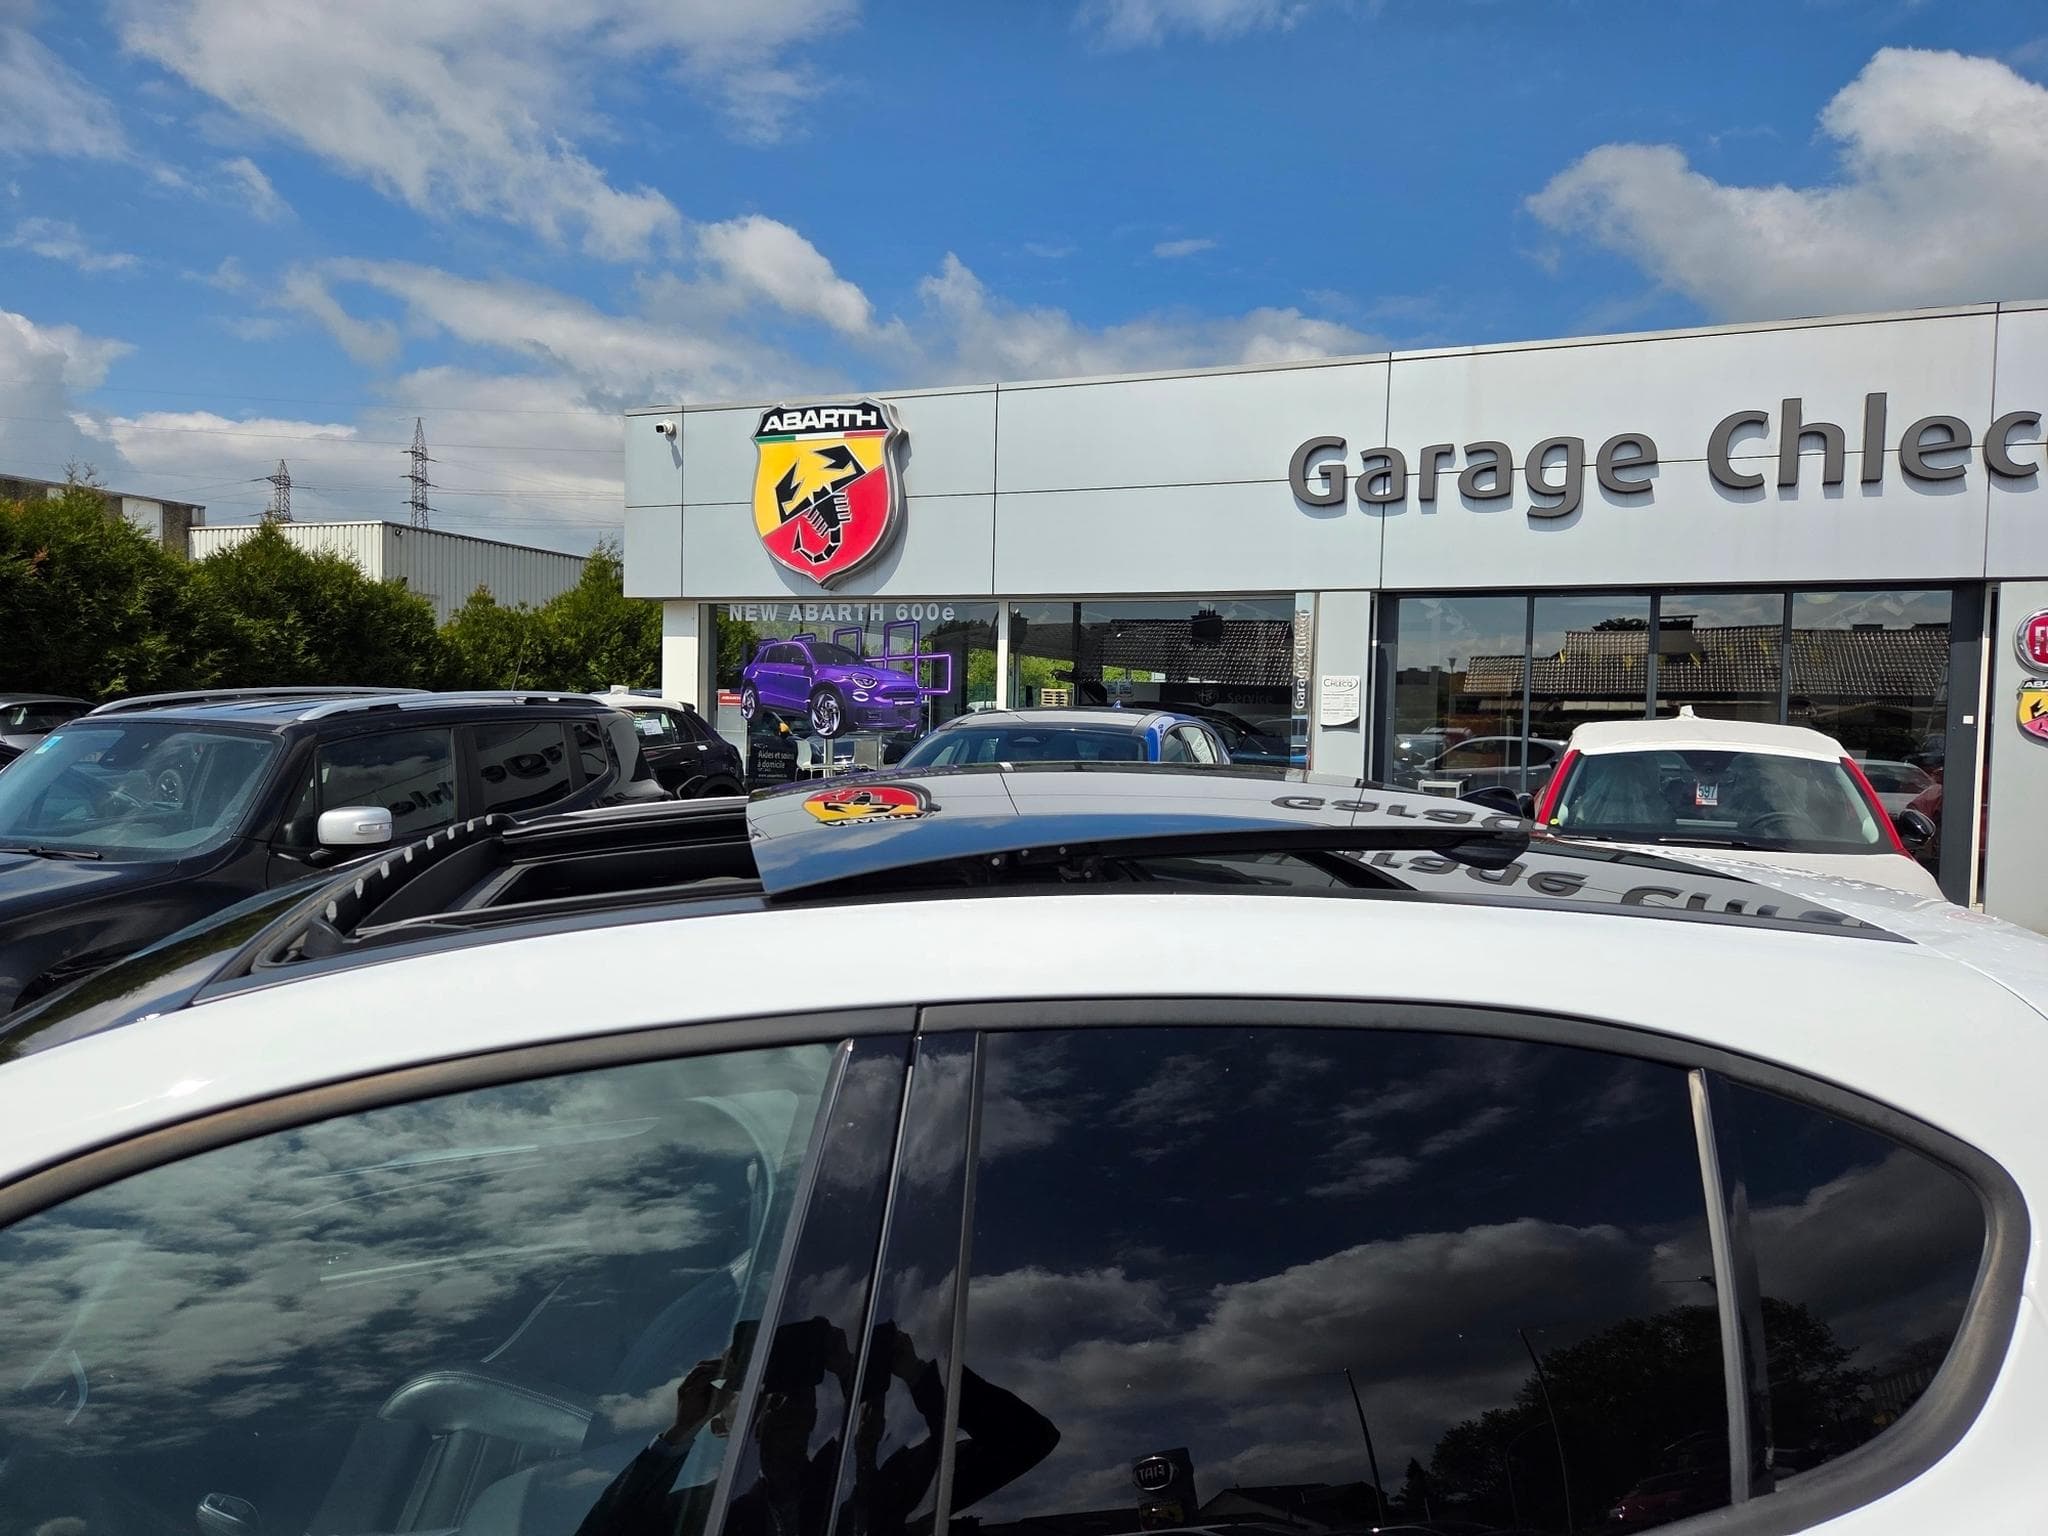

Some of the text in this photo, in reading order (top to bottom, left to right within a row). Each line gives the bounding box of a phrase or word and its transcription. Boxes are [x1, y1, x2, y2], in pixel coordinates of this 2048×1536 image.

[762, 408, 877, 432] ABARTH
[1288, 392, 2048, 519] Garage Chlec
[728, 603, 956, 622] NEW ABARTH 600e
